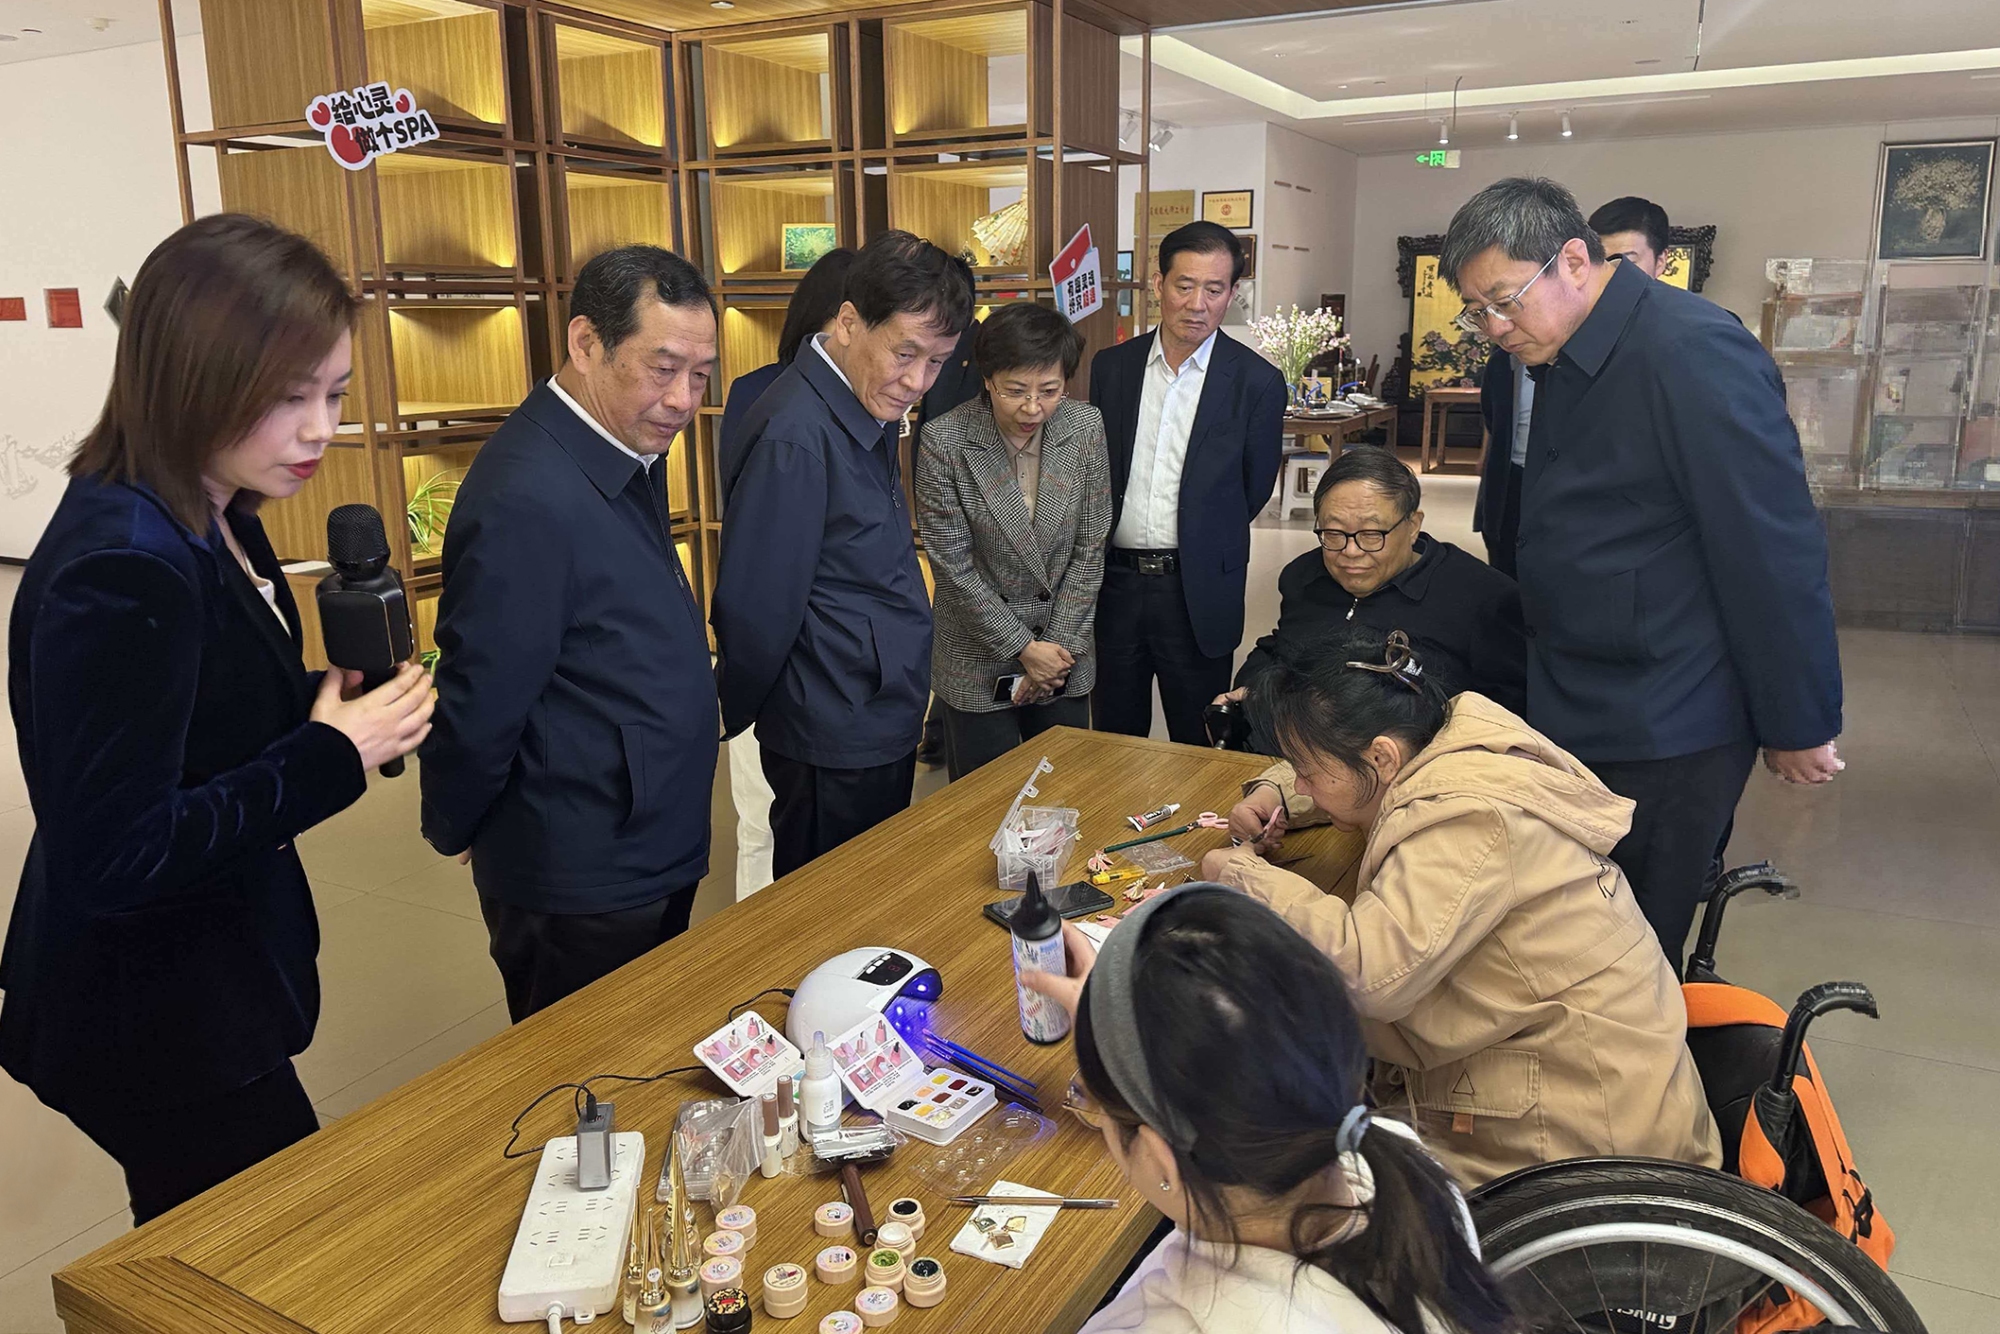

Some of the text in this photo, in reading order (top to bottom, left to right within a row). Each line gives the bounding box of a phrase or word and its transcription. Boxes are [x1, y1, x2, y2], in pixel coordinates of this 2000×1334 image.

[331, 86, 394, 125] 给心灵
[354, 113, 435, 156] 做个SPA
